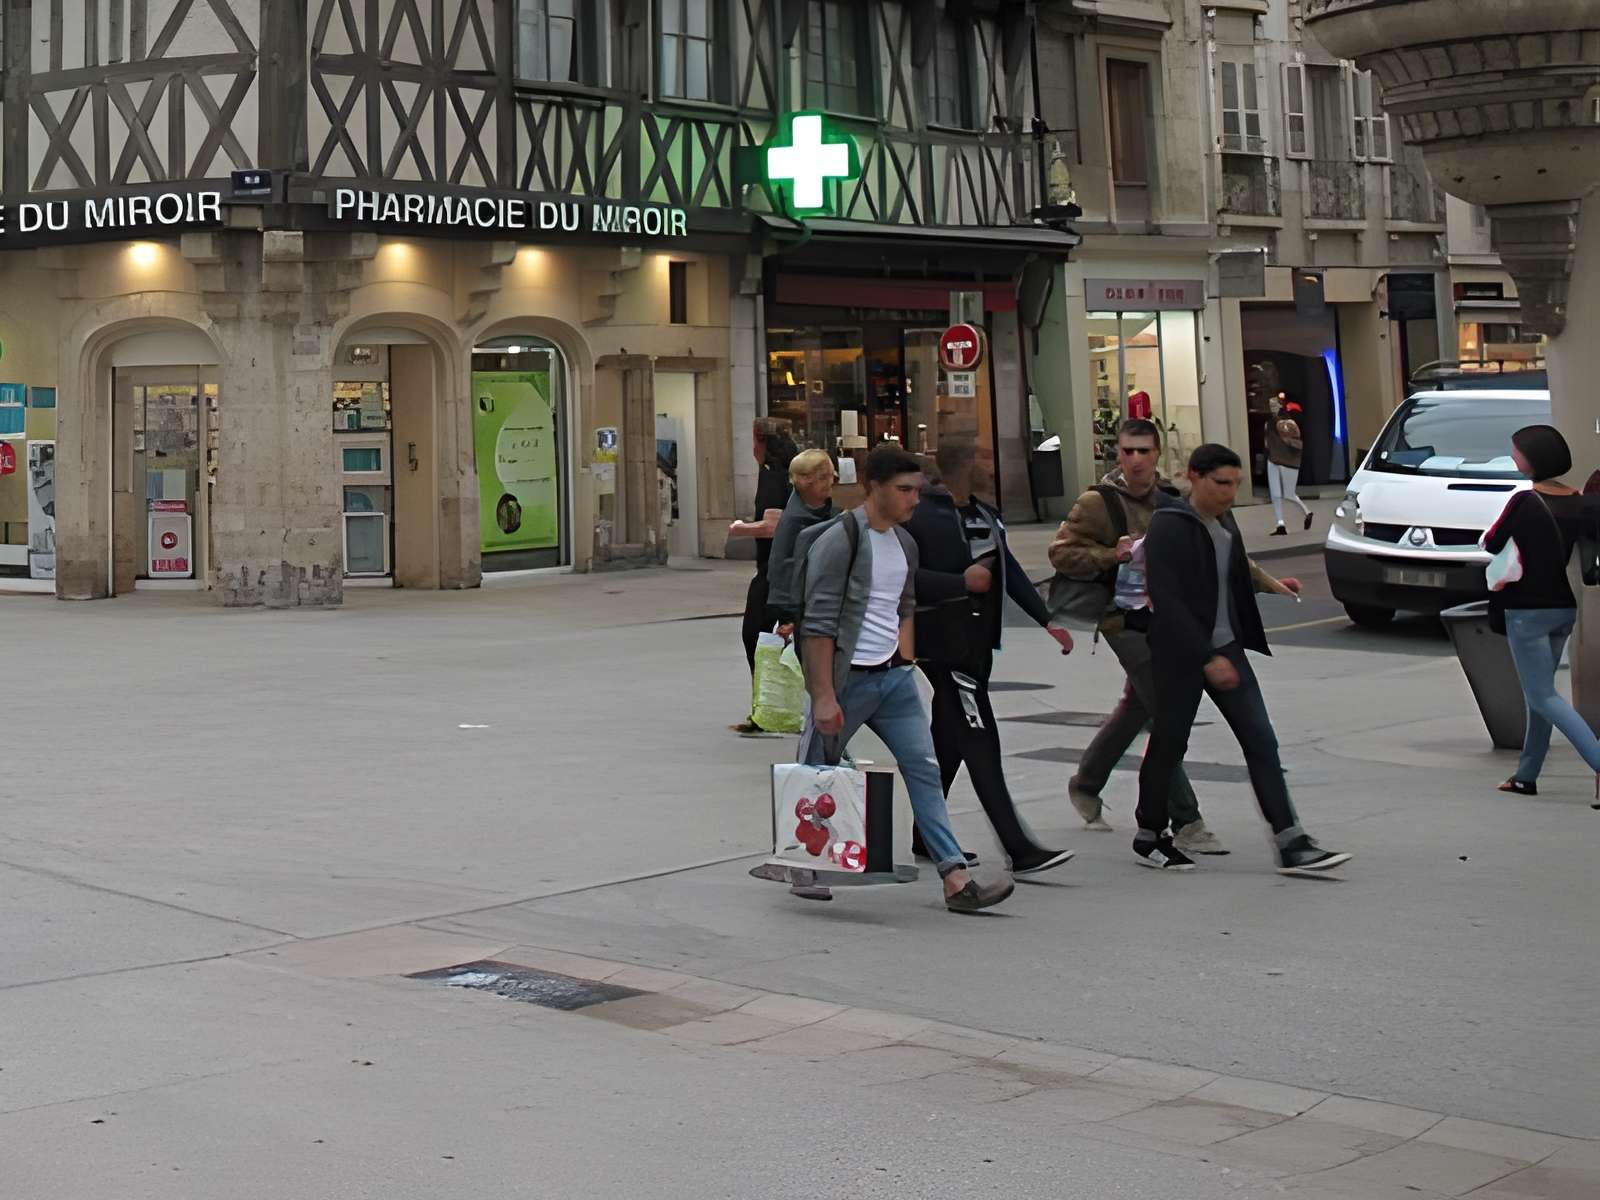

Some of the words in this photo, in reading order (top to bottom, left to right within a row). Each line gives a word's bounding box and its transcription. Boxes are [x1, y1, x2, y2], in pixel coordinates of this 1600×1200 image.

[19, 200, 69, 232] DU
[84, 191, 222, 229] MIROIR
[335, 188, 526, 230] PHARMACIE
[539, 202, 580, 232] DU
